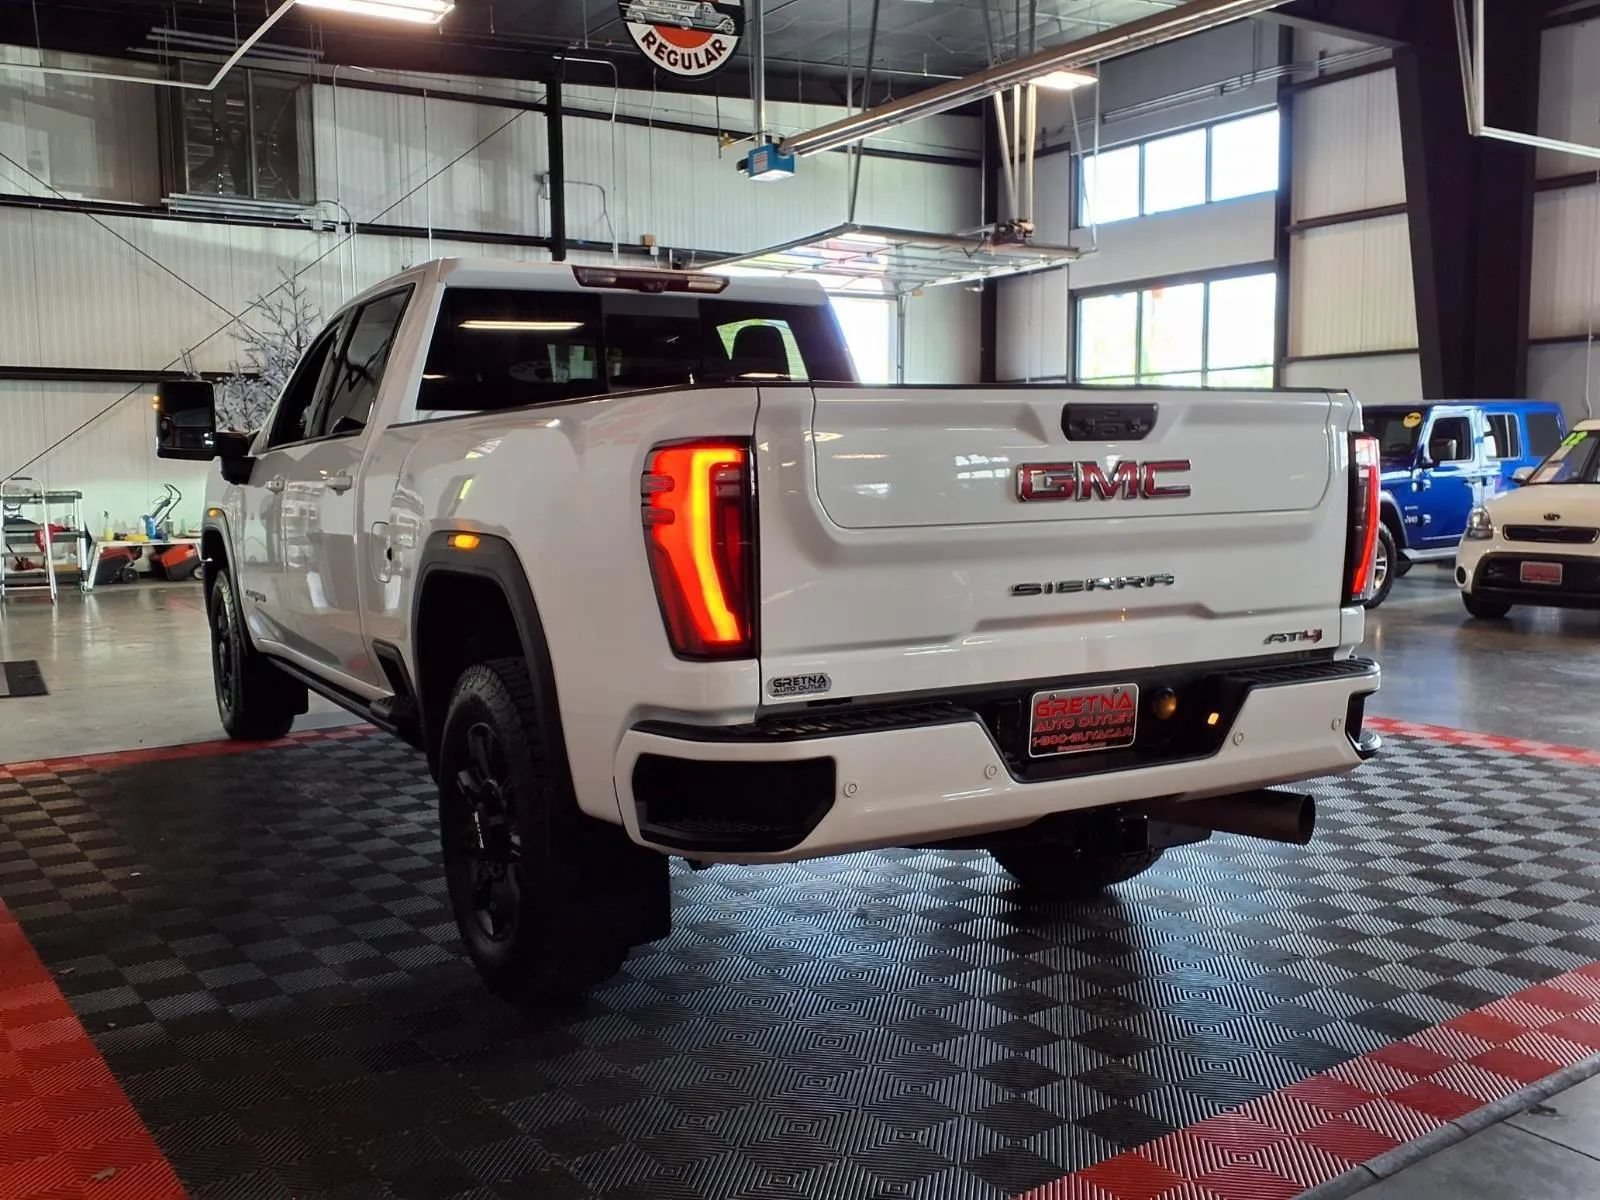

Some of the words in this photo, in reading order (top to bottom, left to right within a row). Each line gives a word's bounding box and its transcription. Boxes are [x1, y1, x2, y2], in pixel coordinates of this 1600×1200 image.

[641, 30, 727, 70] REGULAR
[1016, 459, 1191, 502] GMC
[1010, 573, 1174, 596] SIERRA
[1263, 628, 1322, 645] AT4
[773, 673, 826, 687] GRETNA
[773, 685, 796, 693] AUTO
[798, 682, 826, 690] OUTLET
[1035, 691, 1134, 718] GRETNA
[1034, 718, 1075, 732] AUTO
[1078, 712, 1134, 727] OUTLET
